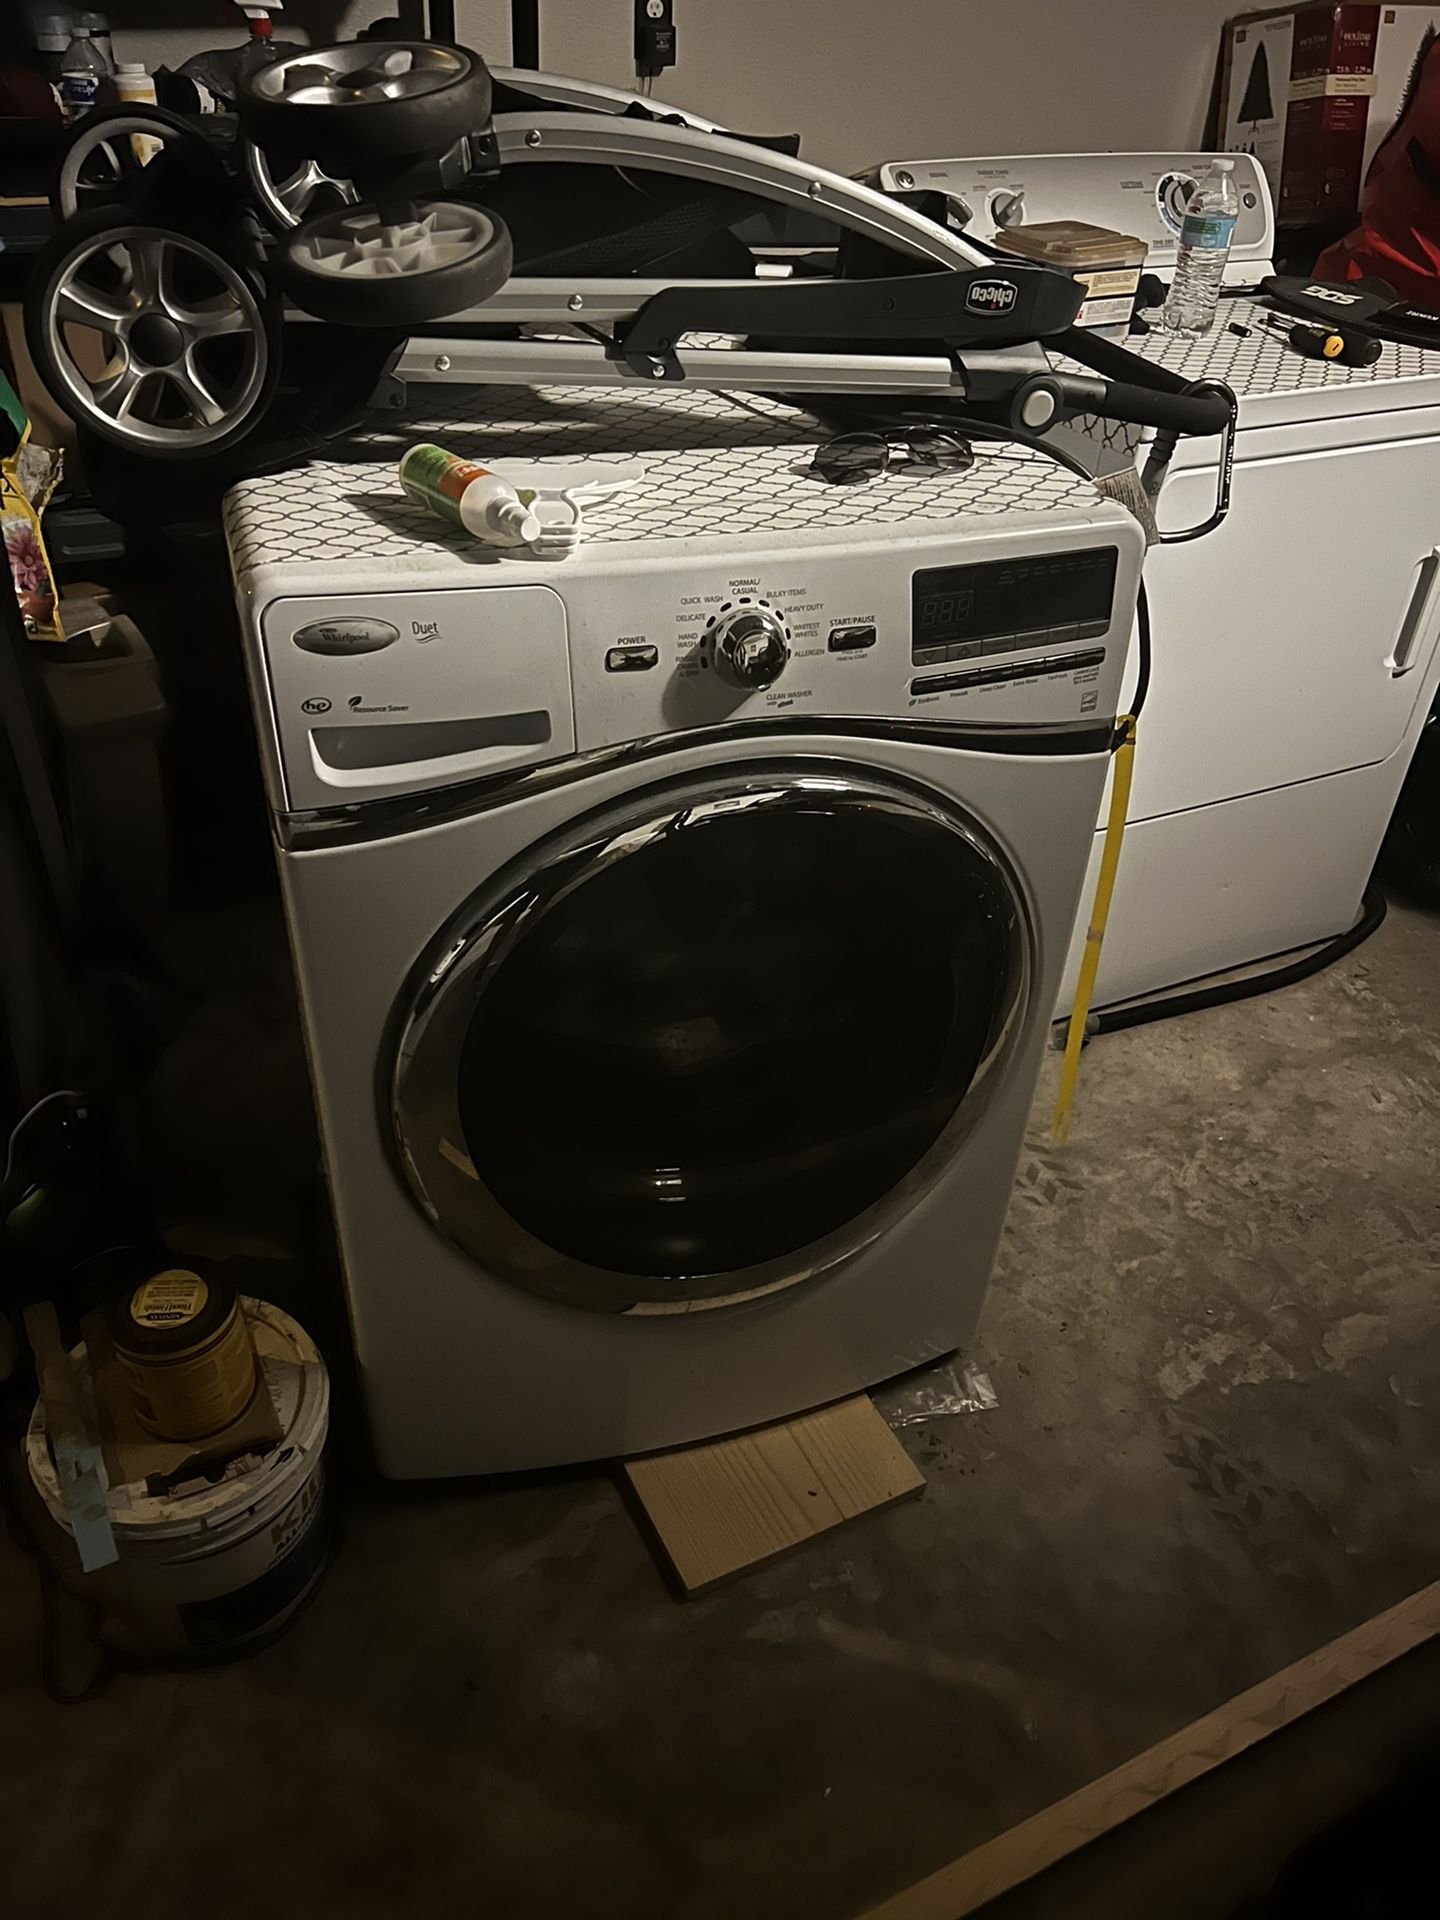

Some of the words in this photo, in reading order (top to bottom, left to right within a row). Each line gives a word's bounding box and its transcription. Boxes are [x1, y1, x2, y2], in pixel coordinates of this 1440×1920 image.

[971, 286, 1014, 308] chicco
[1299, 284, 1363, 306] SOG
[728, 578, 761, 587] NORMAL/
[732, 586, 758, 595] CASUAL
[766, 591, 787, 599] BULKY
[784, 605, 805, 613] HEAVY
[676, 613, 706, 622] DELICATE
[829, 615, 876, 627] START/PAUSE
[412, 622, 438, 635] Duet
[793, 622, 820, 631] WHITEST
[322, 632, 370, 644] Whirlpool
[794, 630, 818, 638] WHITES
[617, 637, 646, 646] POWER
[677, 640, 698, 648] WASH
[794, 649, 825, 658] ALLERGEN
[787, 690, 812, 698] WASHER
